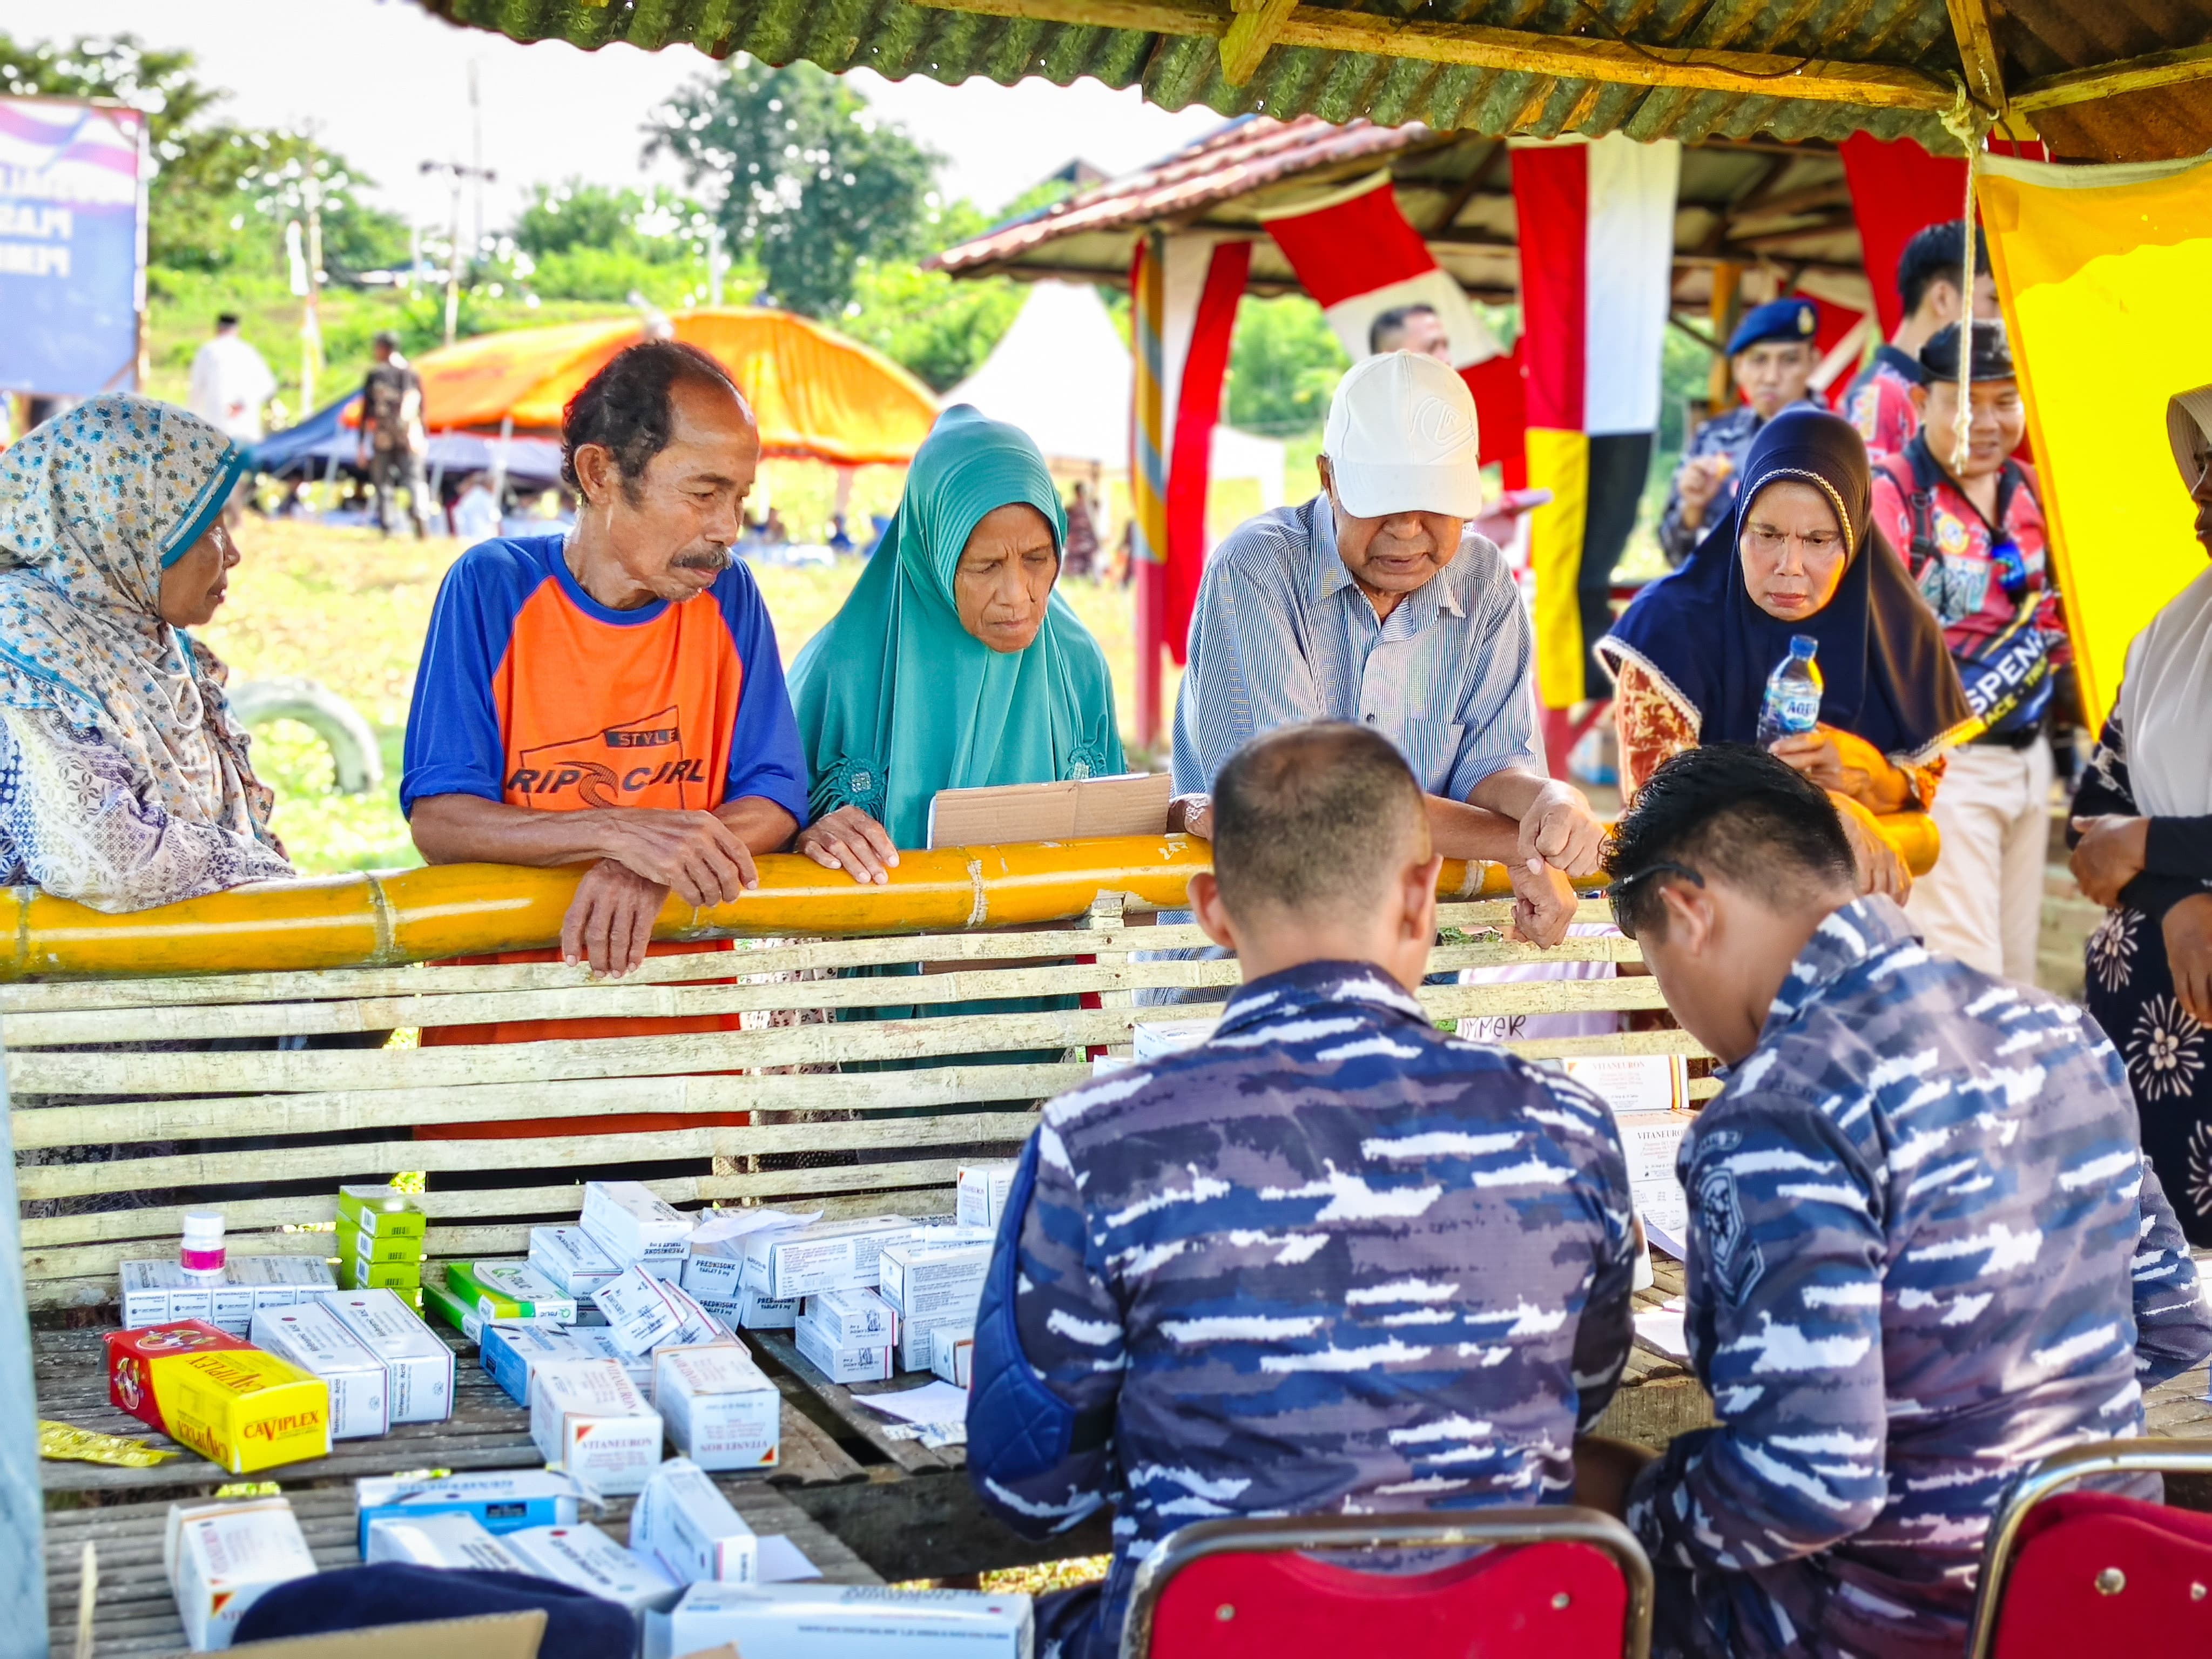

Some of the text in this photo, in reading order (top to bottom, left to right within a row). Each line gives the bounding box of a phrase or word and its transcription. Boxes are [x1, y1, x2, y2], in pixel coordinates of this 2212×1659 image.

[618, 730, 676, 746] STYLE
[507, 767, 583, 794] RIP
[1637, 1128, 1684, 1140] VITANEURO
[696, 1259, 737, 1270] PREDNISONE
[699, 1299, 738, 1309] PREDNISONE
[186, 1355, 266, 1393] CAVIPLEX
[244, 1410, 320, 1441] CAVIPLEX
[583, 1438, 653, 1449] VITANEURON
